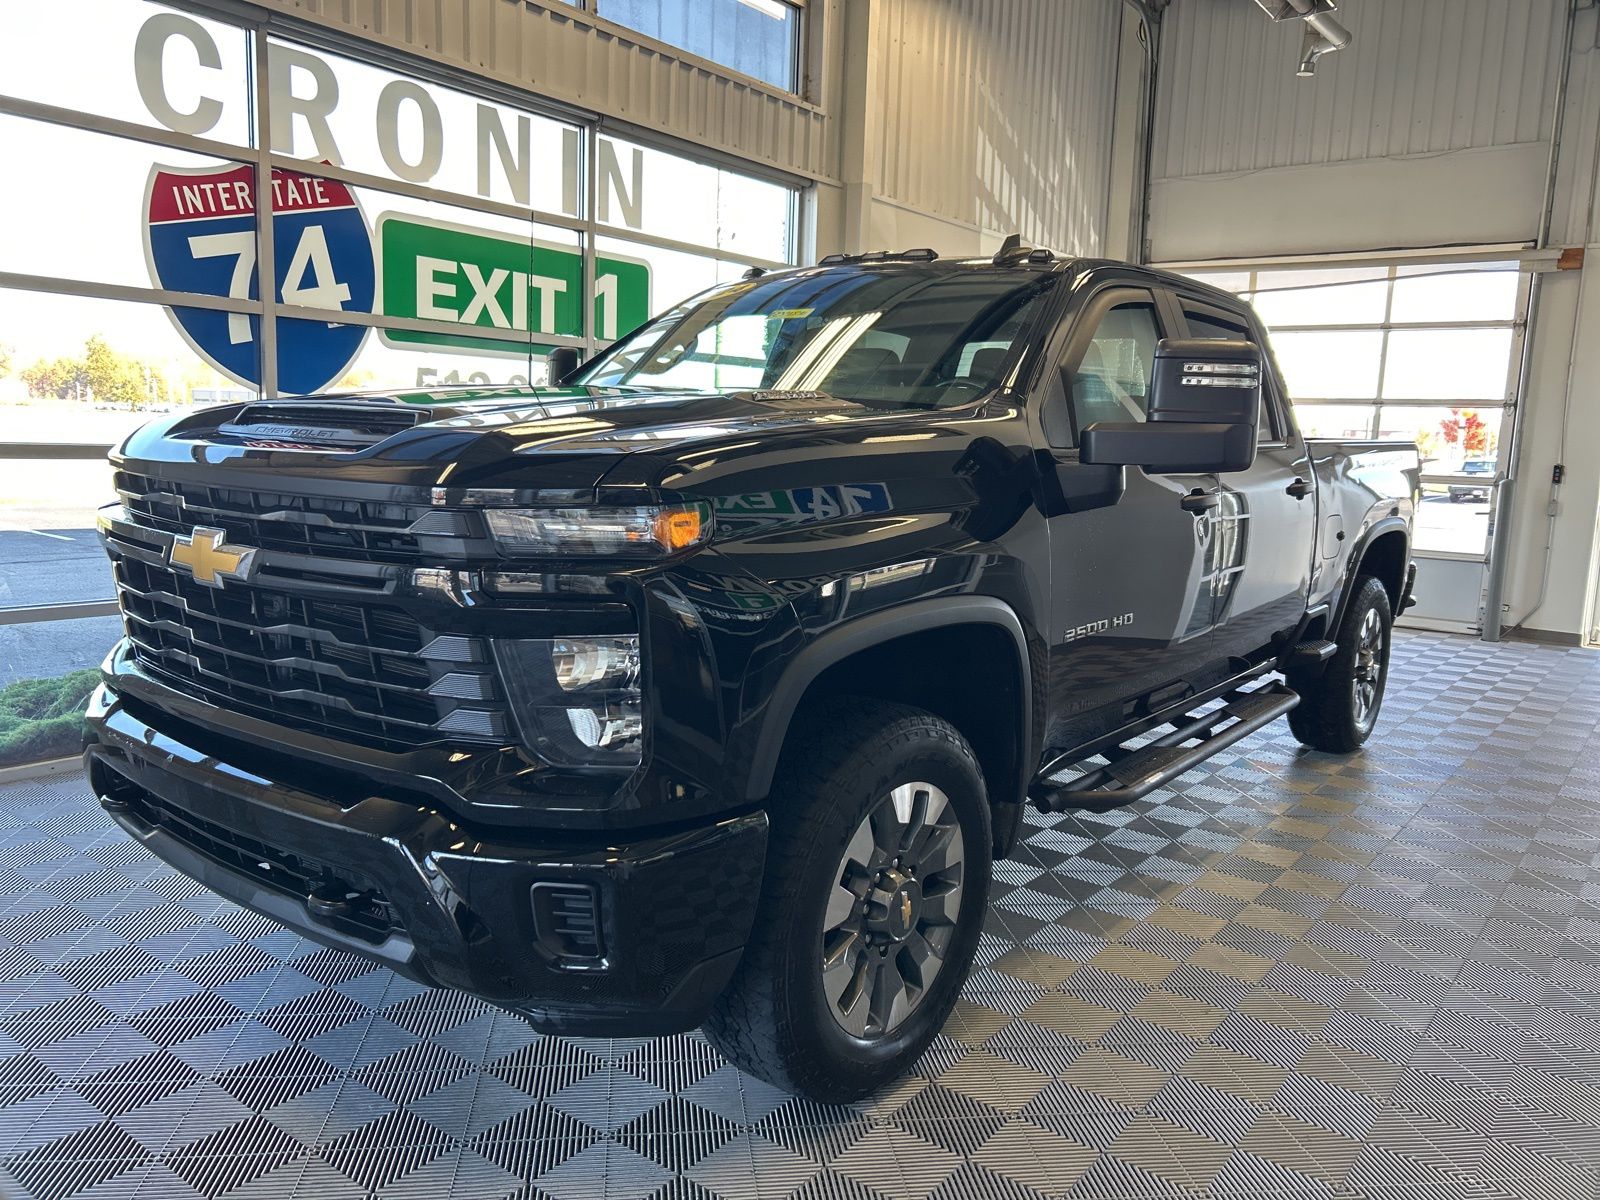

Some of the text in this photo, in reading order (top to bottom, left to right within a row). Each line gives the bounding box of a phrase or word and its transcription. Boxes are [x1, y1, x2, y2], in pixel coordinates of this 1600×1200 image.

[134, 13, 644, 230] CRONIN
[172, 177, 330, 215] INTERTATE
[187, 225, 352, 345] 74
[415, 255, 618, 340] EXIT 1
[255, 426, 339, 438] CHEVROLET
[1063, 612, 1134, 643] 2500 HD
